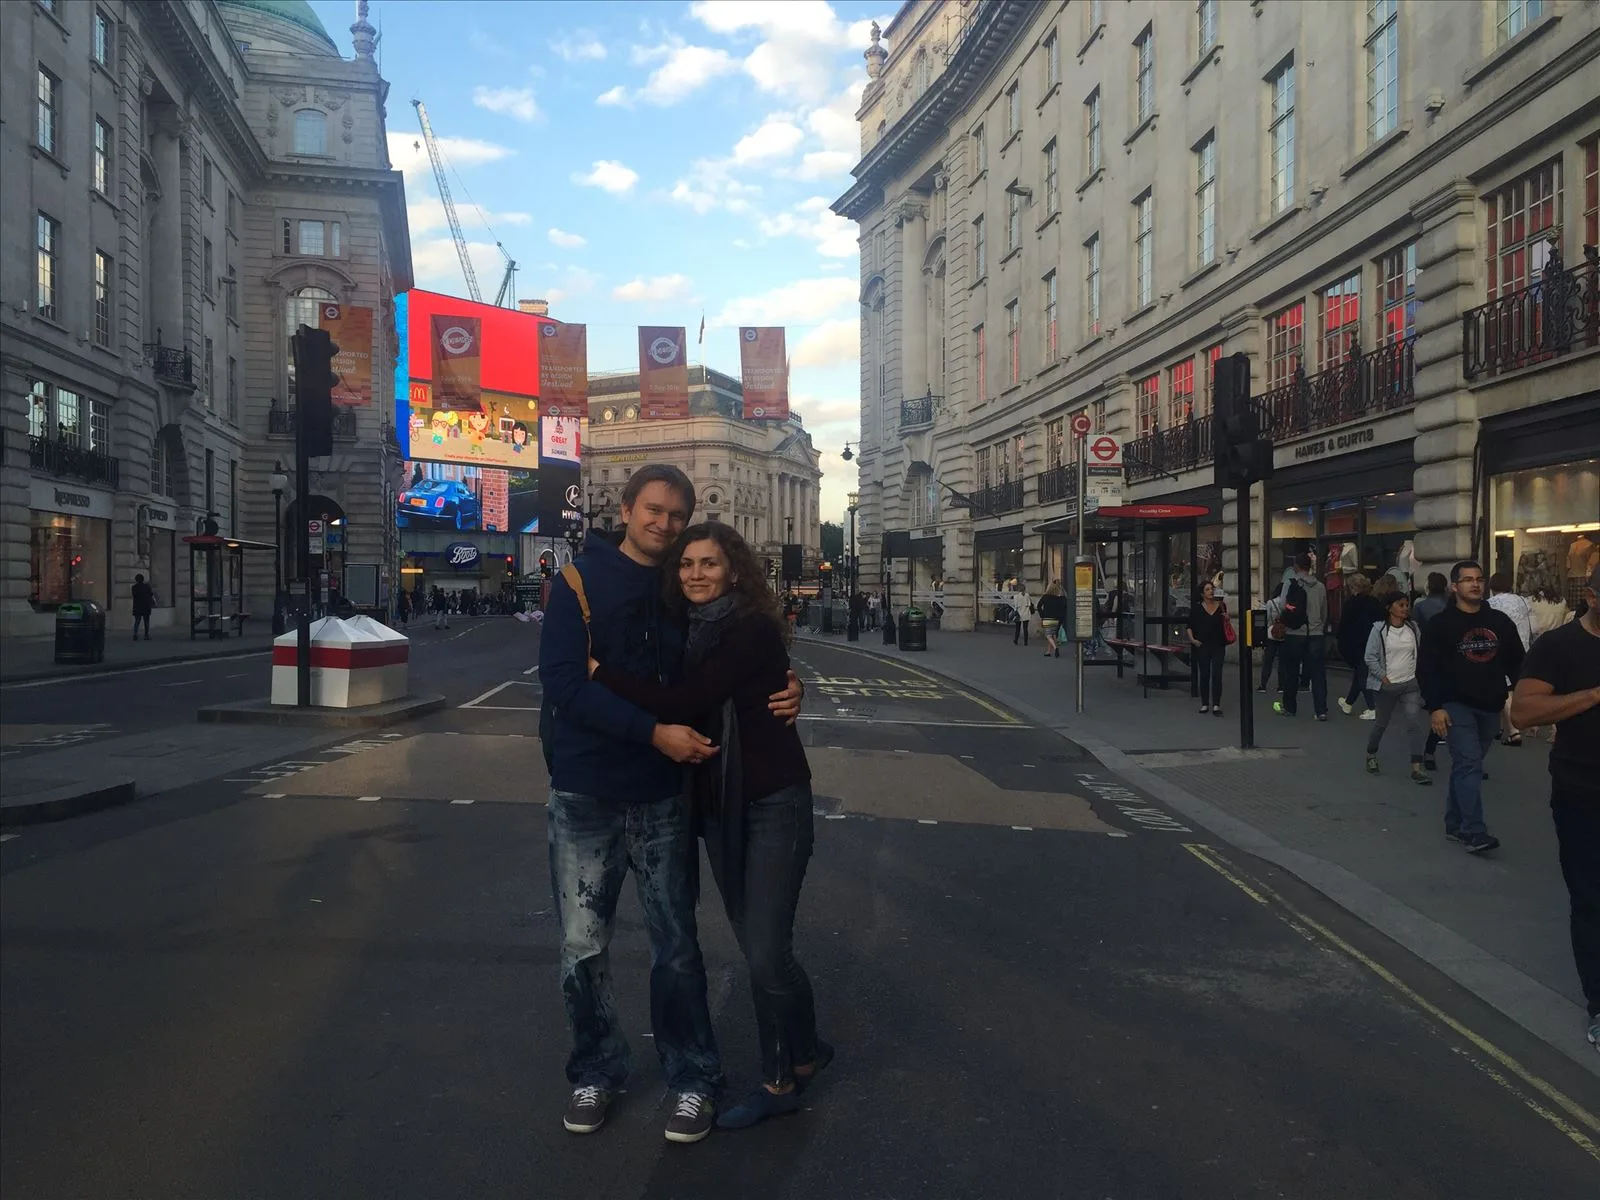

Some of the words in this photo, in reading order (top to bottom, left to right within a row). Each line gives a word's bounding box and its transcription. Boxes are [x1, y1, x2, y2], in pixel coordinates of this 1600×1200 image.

[1074, 417, 1087, 431] C
[551, 435, 568, 445] GREAT
[1295, 441, 1325, 458] HAWES
[1328, 438, 1335, 451] &
[1337, 428, 1374, 449] CURTIS
[53, 487, 90, 508] NESPRESSO
[450, 546, 478, 565] Boots
[817, 686, 944, 700] BUS
